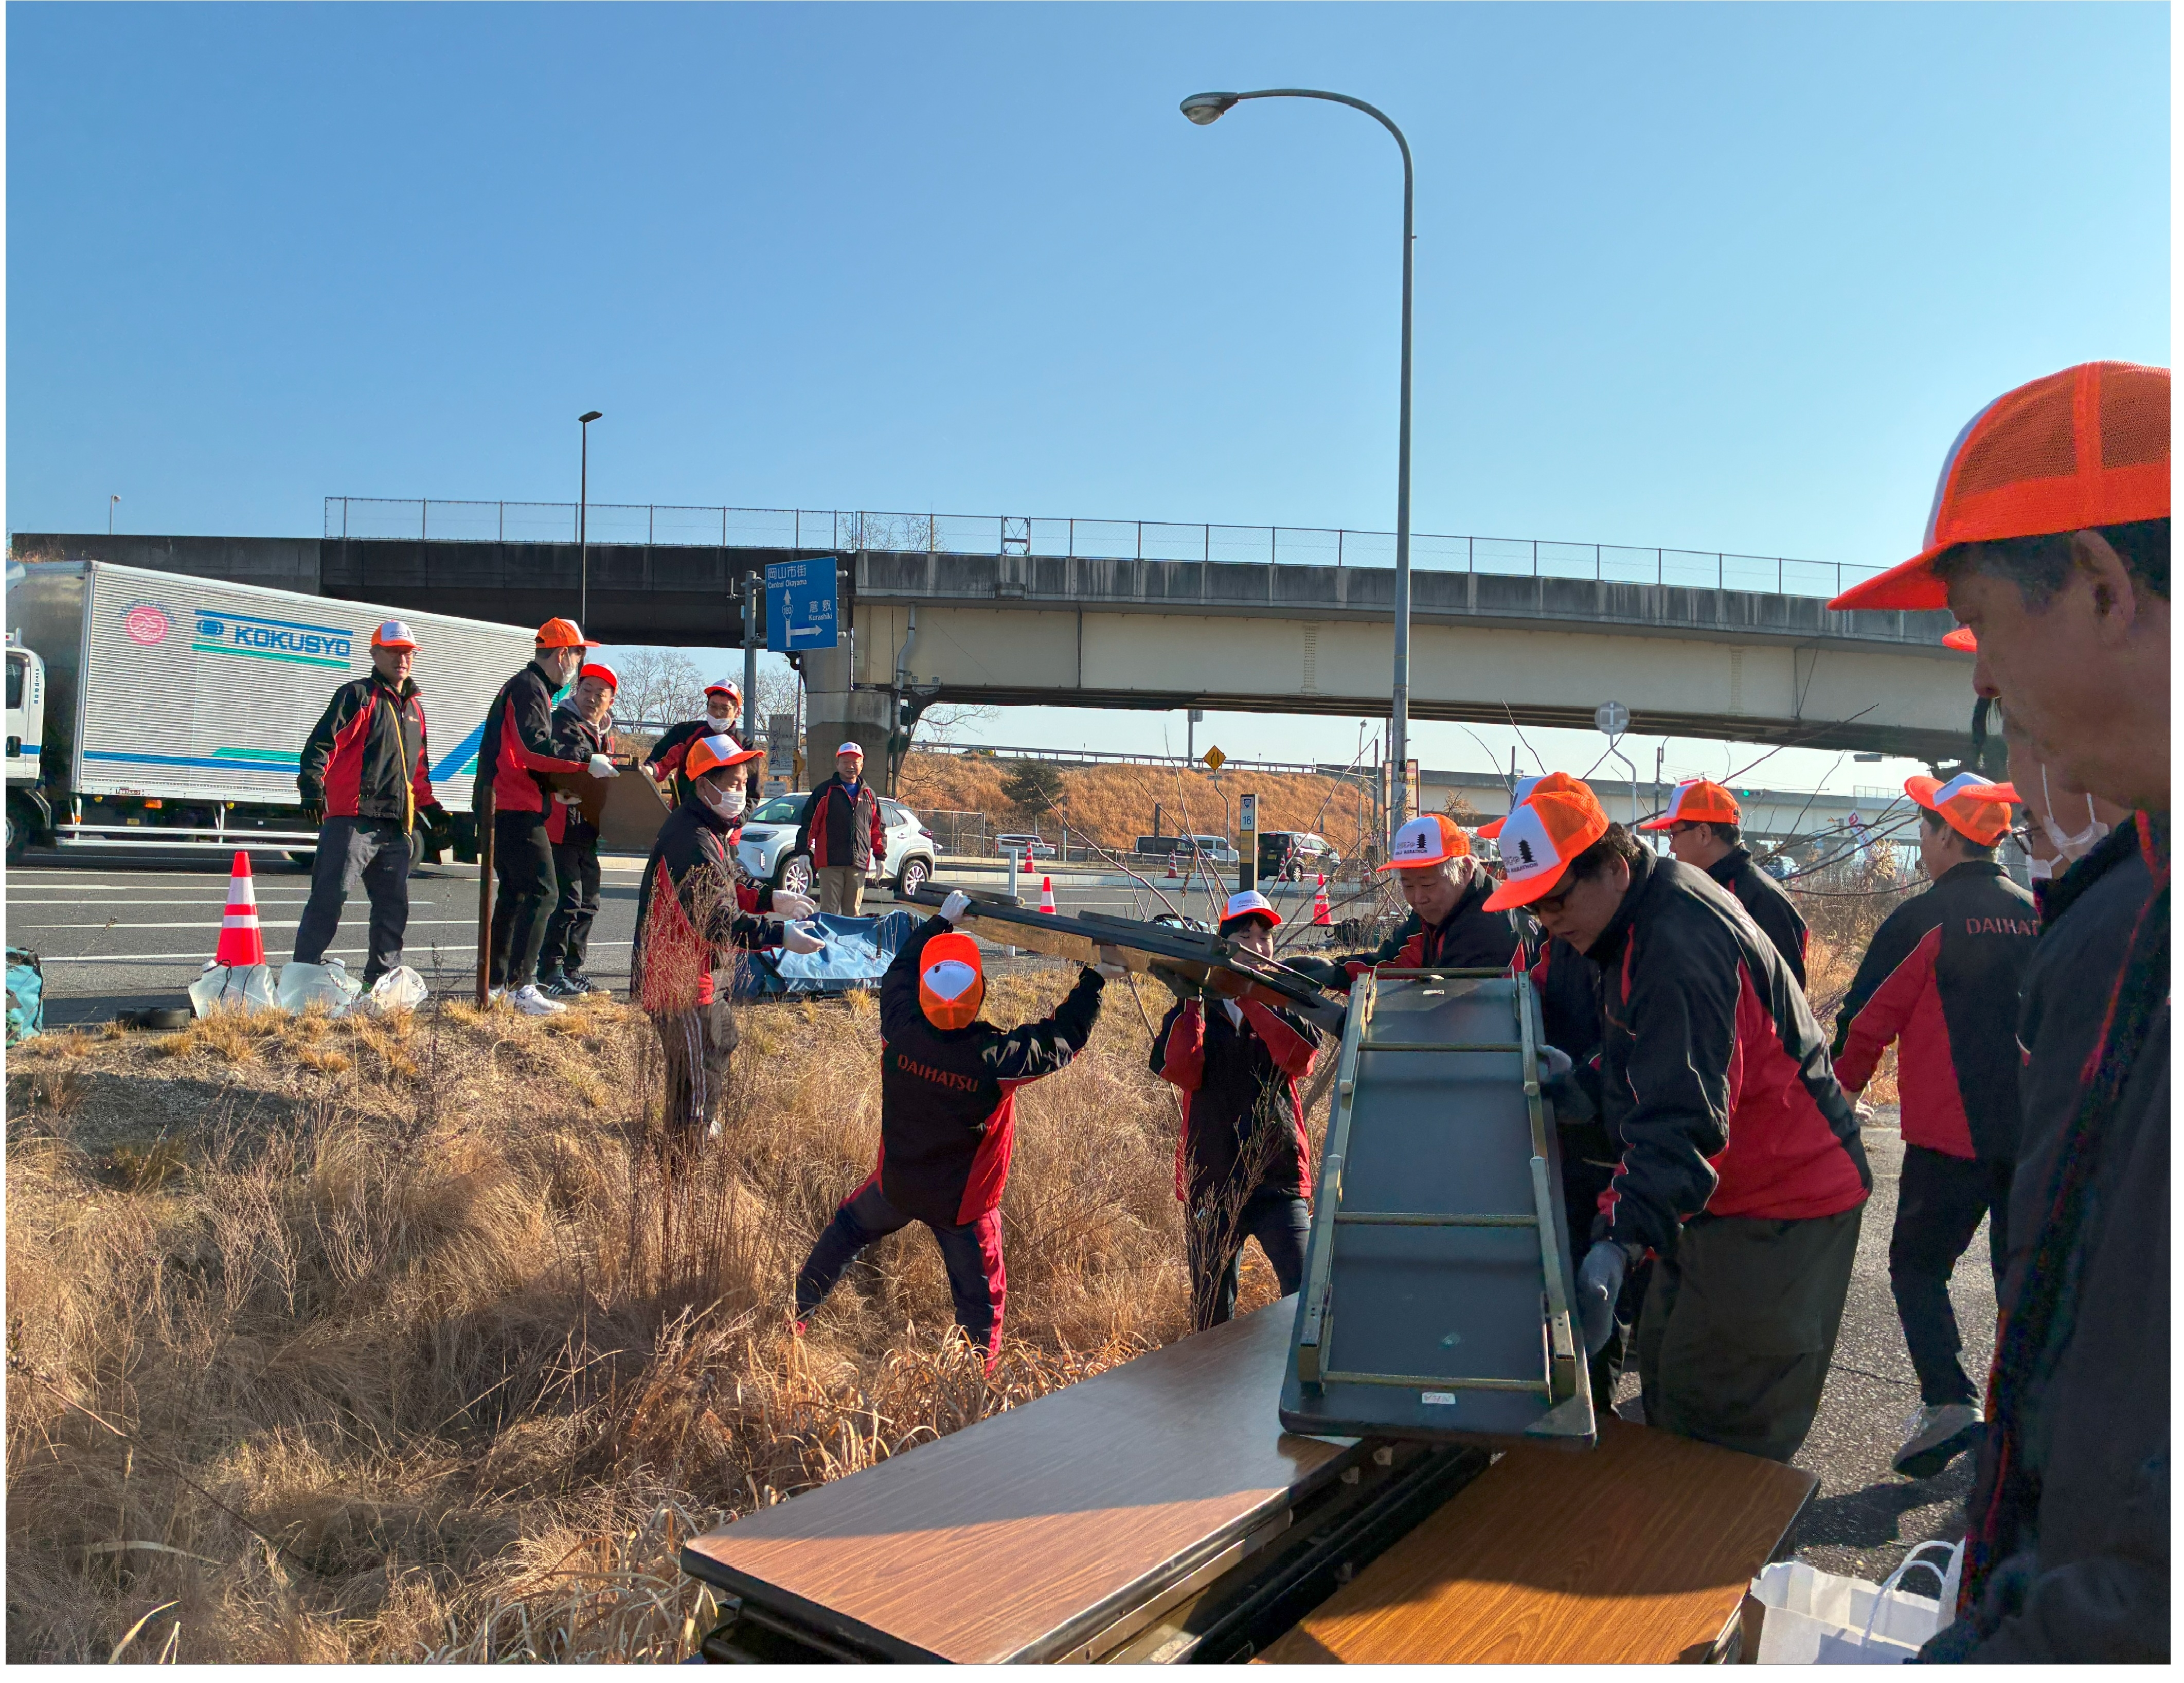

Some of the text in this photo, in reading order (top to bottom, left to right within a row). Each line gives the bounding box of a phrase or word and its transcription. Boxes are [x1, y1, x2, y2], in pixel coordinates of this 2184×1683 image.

[768, 565, 806, 580] 岡山市街
[768, 579, 807, 589] Central Okayama
[809, 599, 832, 613] 倉敷
[808, 613, 833, 621] Kurashiki
[235, 625, 351, 657] KOKUSYO
[1242, 816, 1251, 825] 16
[1966, 917, 2042, 937] DAIHAT
[898, 1054, 978, 1092] DAIHATSU
